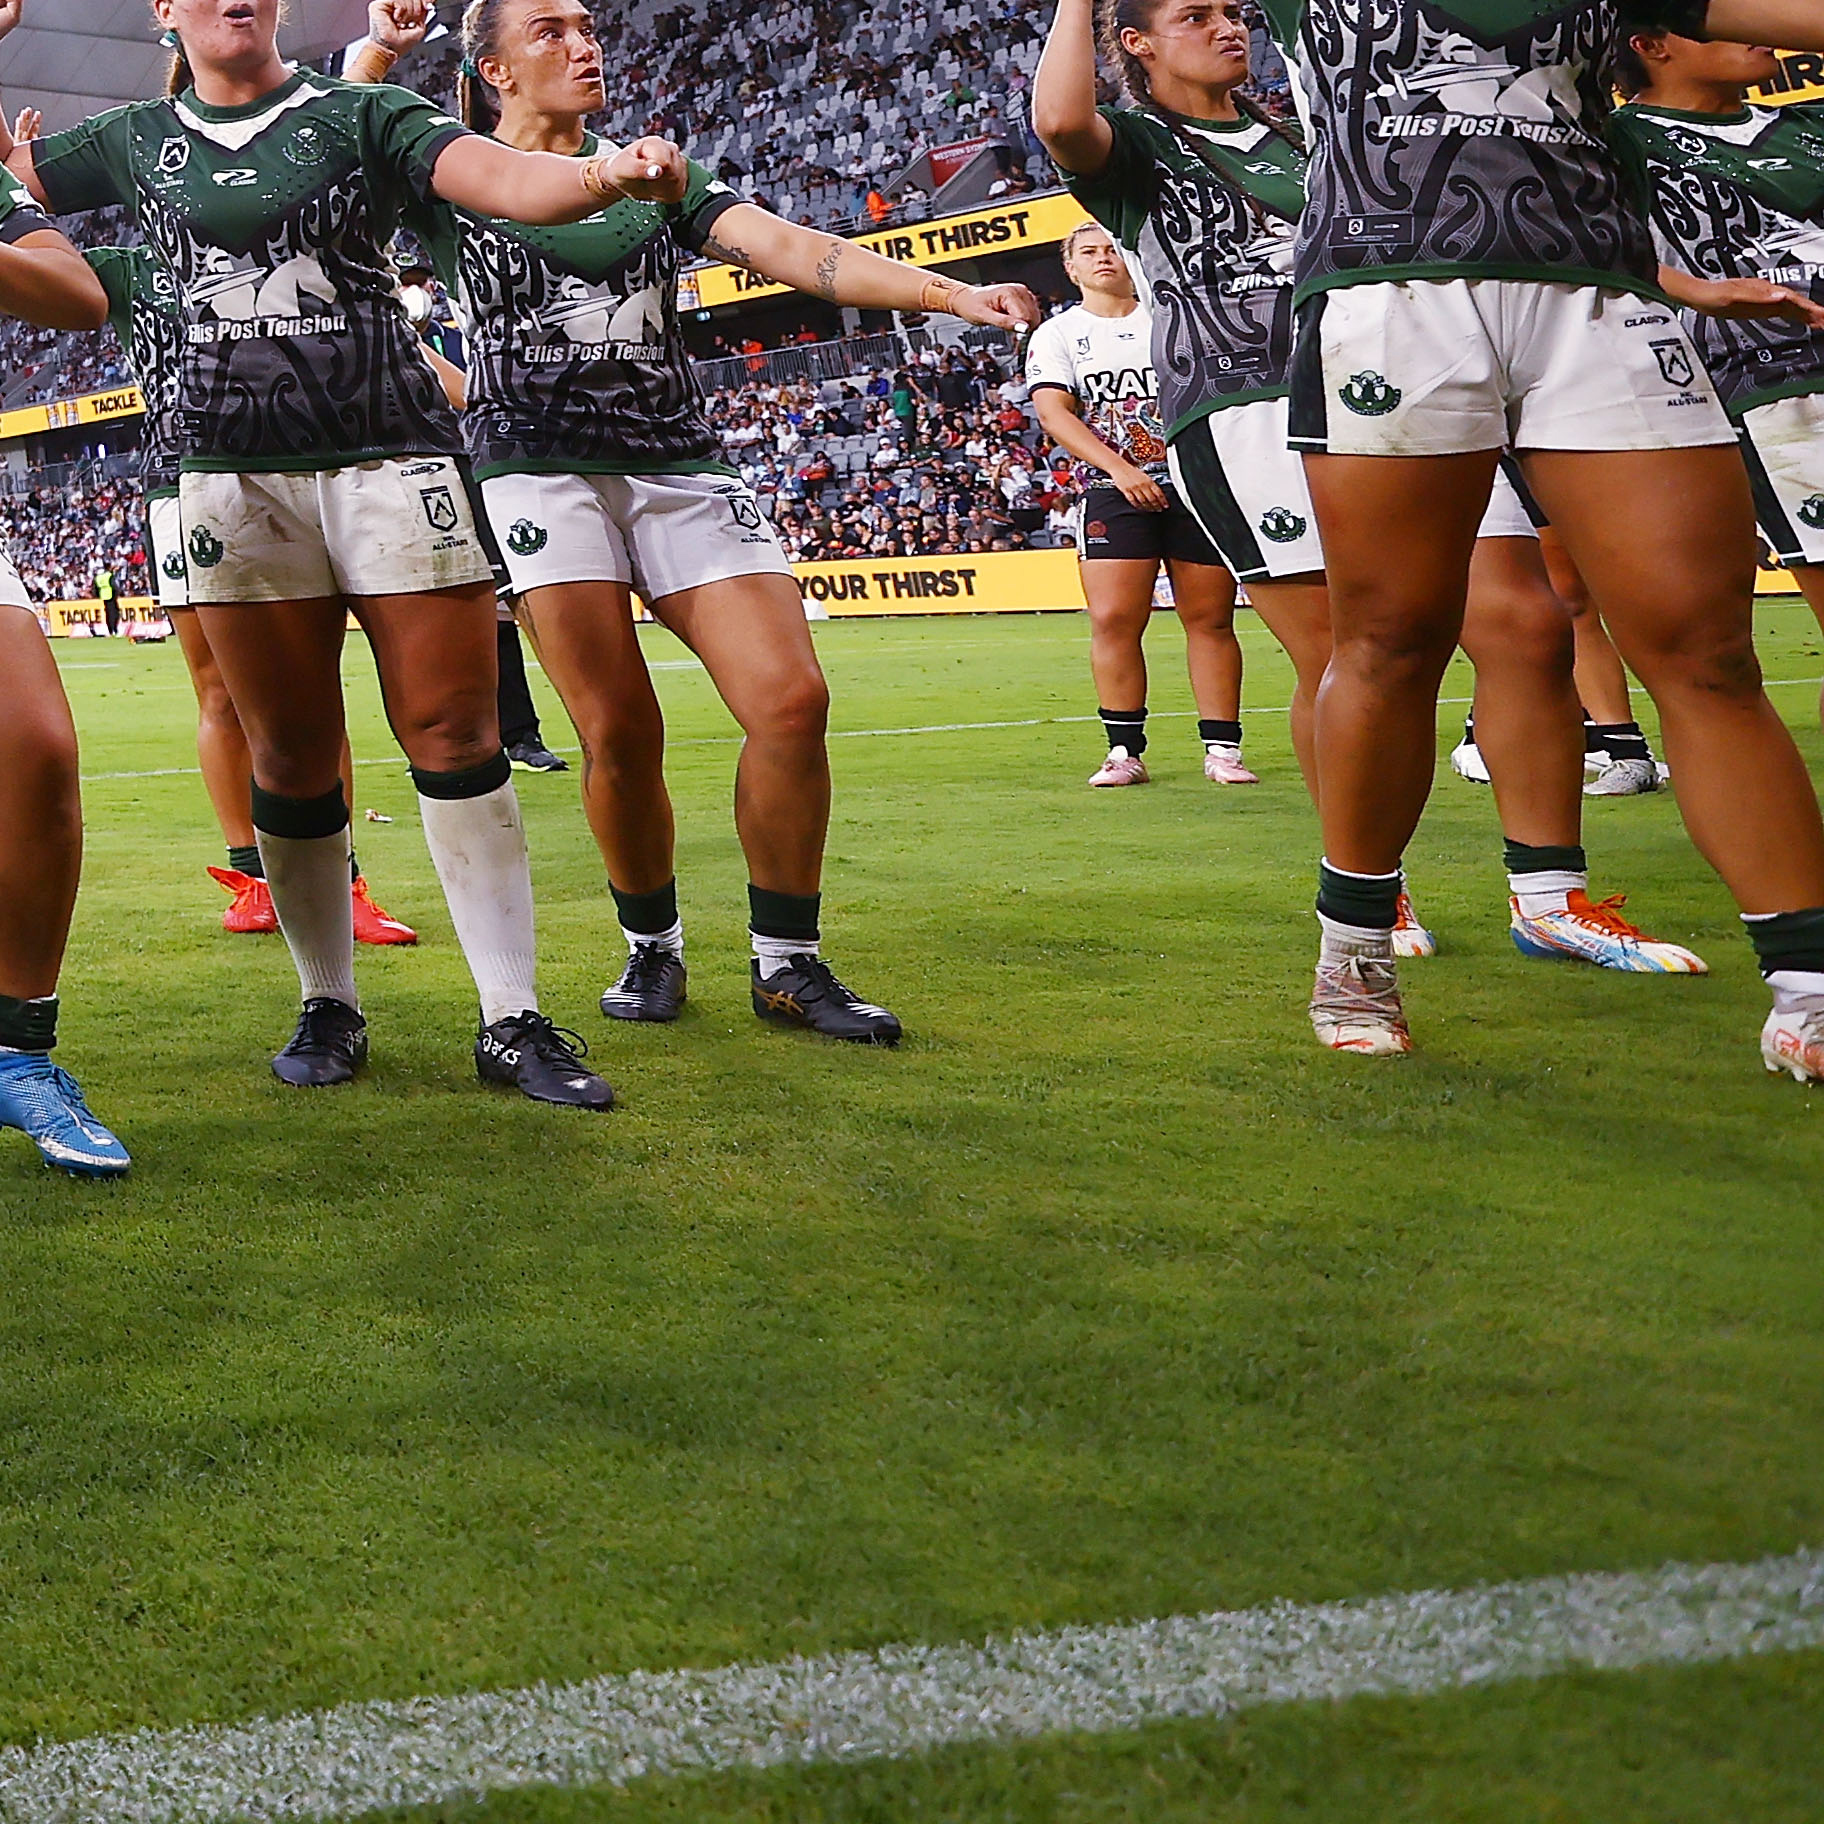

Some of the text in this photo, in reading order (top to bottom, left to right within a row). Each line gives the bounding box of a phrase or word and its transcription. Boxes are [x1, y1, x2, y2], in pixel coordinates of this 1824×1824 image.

[1378, 115, 1437, 137] Ellis
[1440, 114, 1504, 137] Post
[919, 212, 1030, 256] THIRST
[1232, 273, 1274, 293] Ellis
[188, 313, 347, 344] Ellis Post Tension
[524, 340, 665, 364] Ellis Post Tension
[91, 392, 138, 414] TACKLE
[872, 569, 977, 598] THIRST
[59, 608, 102, 627] TACKLE
